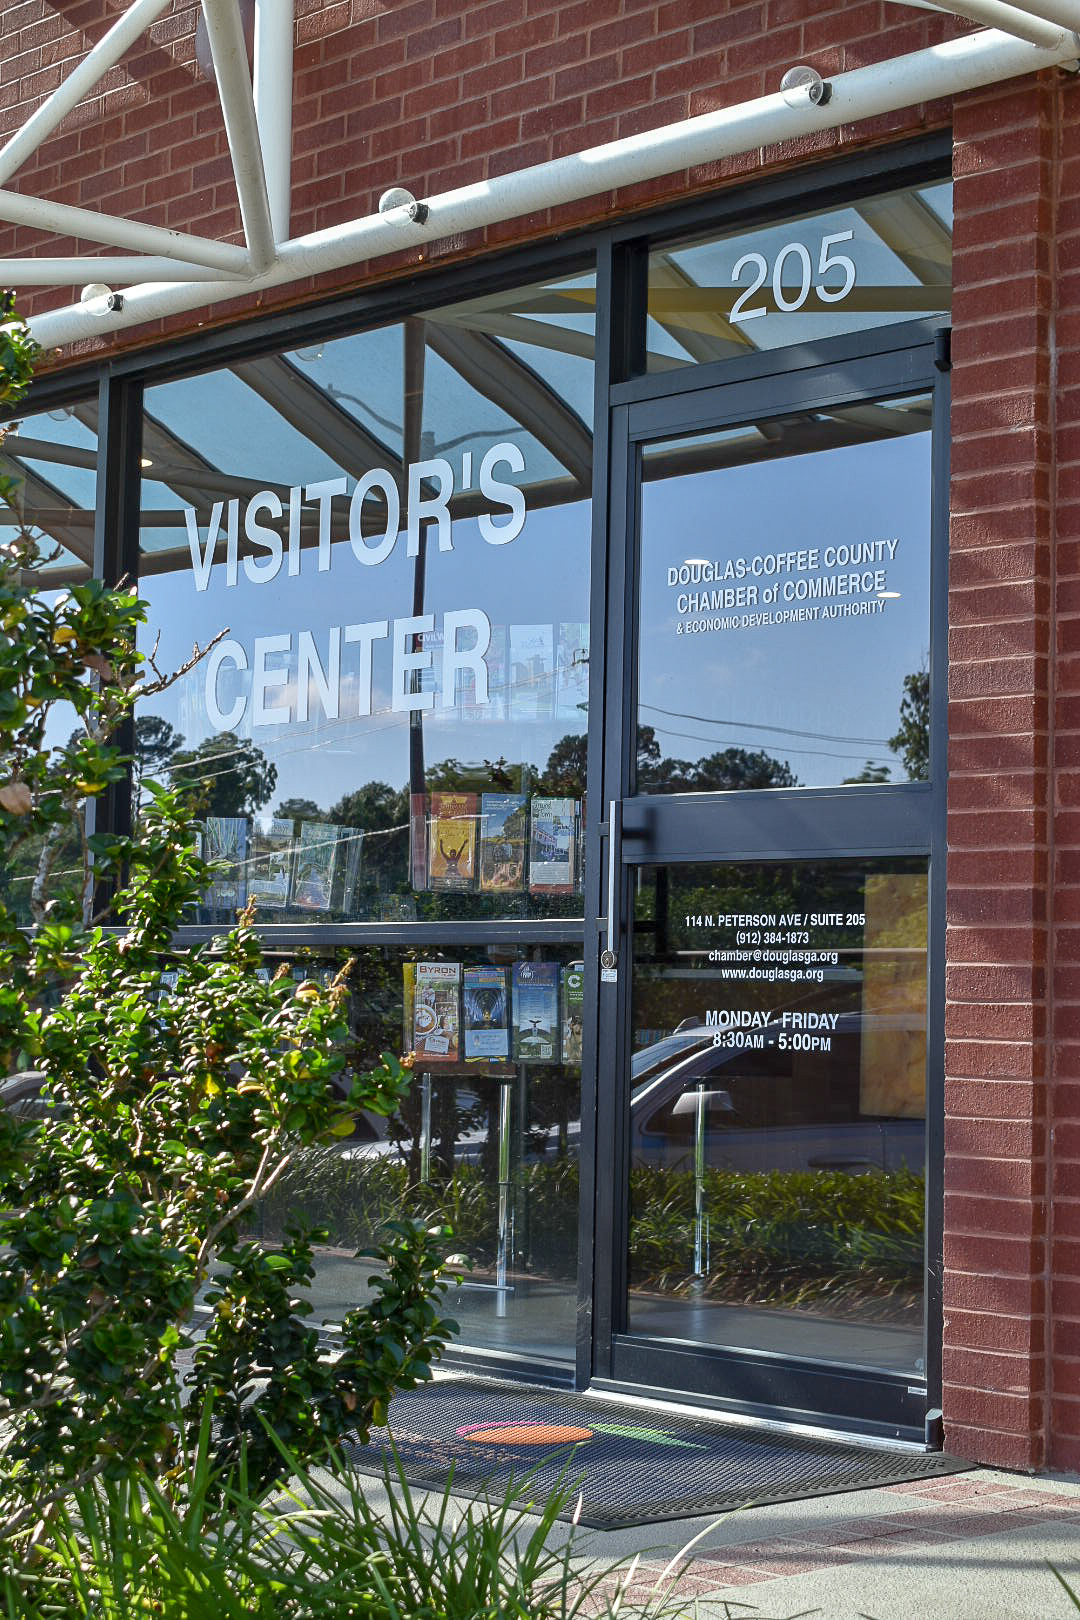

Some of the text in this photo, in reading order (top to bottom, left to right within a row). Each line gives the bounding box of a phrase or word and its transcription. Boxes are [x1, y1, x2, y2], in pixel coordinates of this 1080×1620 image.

[729, 229, 856, 323] 205
[184, 442, 526, 591] VISITOR'S
[667, 539, 899, 586] DOUGLAS-COFFEE COUNTY
[677, 570, 886, 613] CHAMBER of COMMERCE
[676, 600, 885, 634] & ECONOMIC DEVELOPMENT AUTHORITY
[205, 608, 492, 732] CENTER
[685, 914, 866, 927] 114 N. PETERSON AVE / SUITE 205
[736, 931, 809, 945] (912) 384-1873
[708, 950, 839, 964] chamber@douglasga.org
[419, 965, 456, 974] BYRON
[721, 967, 824, 982] www.douglasga.org
[705, 1011, 771, 1027] MONDAY
[782, 1013, 839, 1030] FRIDAY
[712, 1032, 764, 1049] 8:30AM
[778, 1033, 831, 1051] 5:00PM
